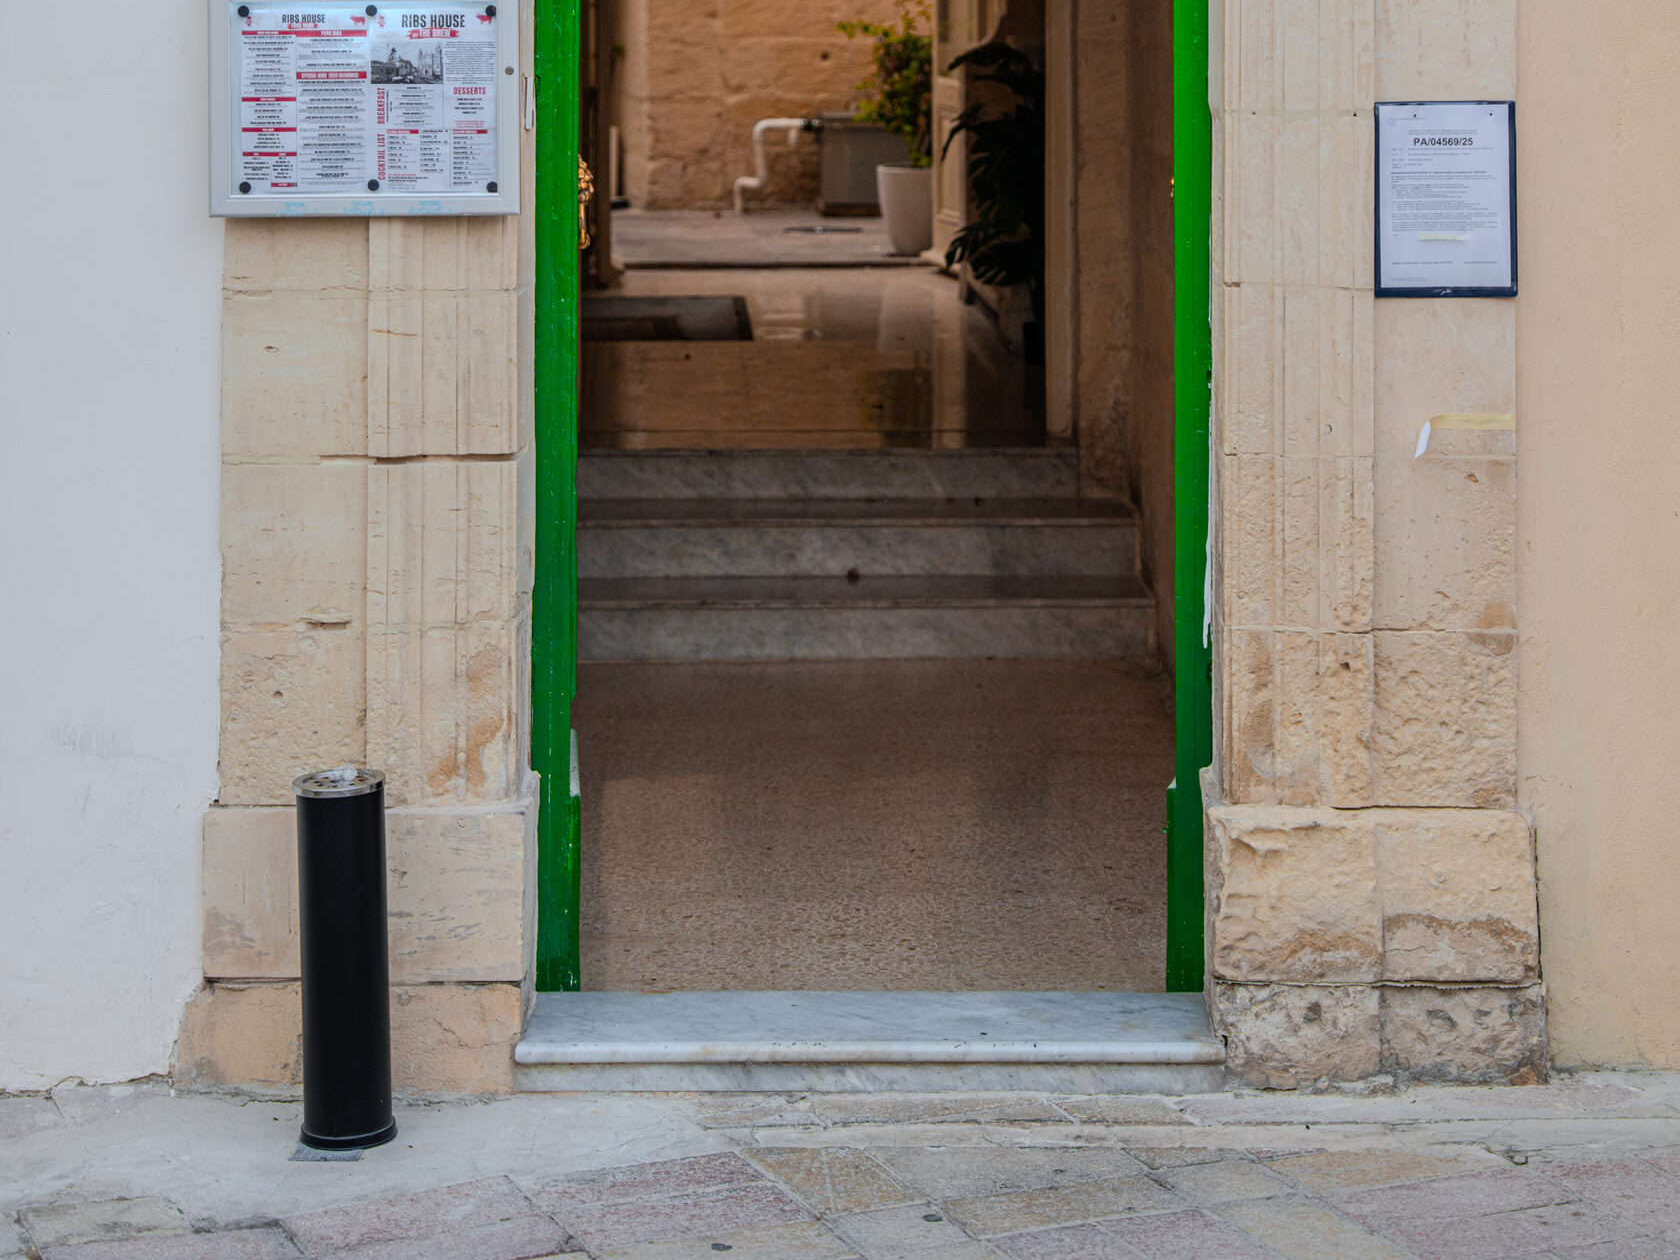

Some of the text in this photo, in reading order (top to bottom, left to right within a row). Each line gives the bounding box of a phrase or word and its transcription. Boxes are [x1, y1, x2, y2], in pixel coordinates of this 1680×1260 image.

[282, 14, 325, 23] RIBS HOUSE
[401, 14, 465, 28] RIBS HOUSE
[453, 87, 487, 95] DESSERTS
[377, 88, 385, 124] BREAKFAST
[1413, 137, 1473, 146] PA/04569/25
[377, 133, 386, 180] COCKTAIL LIST
